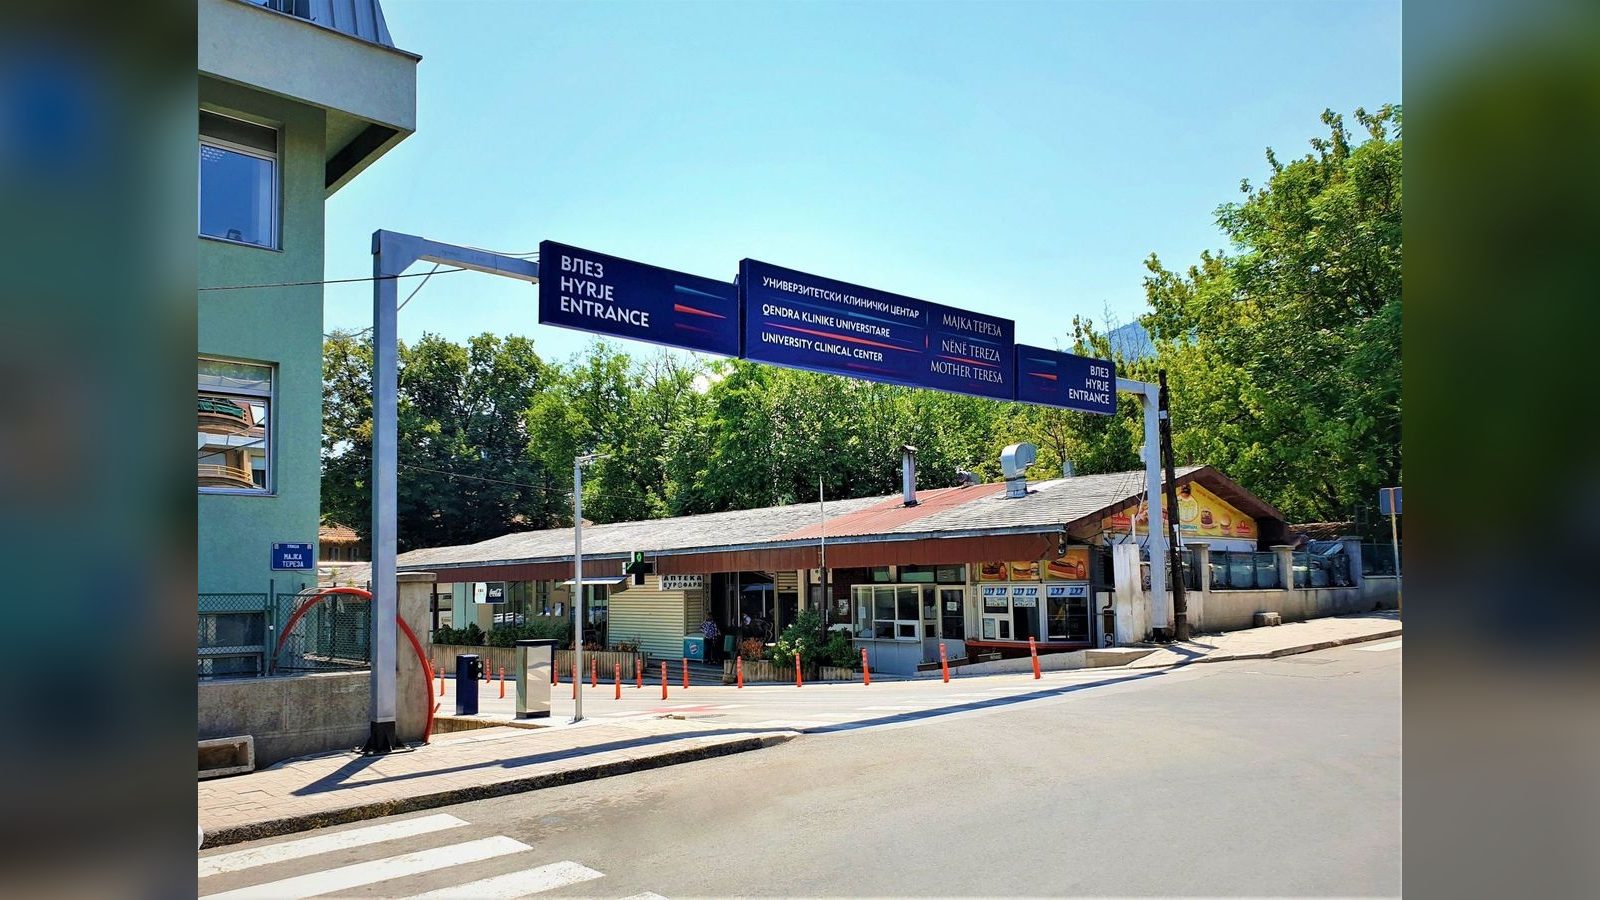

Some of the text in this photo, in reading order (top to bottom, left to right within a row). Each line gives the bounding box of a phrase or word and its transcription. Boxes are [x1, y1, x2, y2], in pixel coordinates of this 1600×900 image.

[561, 255, 604, 278] ВЛЕЗ
[560, 275, 614, 302] HYRJE
[762, 276, 920, 319] УНИВЕРЗИТЕТСКИ КЛИНИЧКИ ЦЕНТАР
[560, 295, 650, 328] ENTRANCE
[762, 303, 891, 338] QENDRA KLINIKE UNIVERSITARE
[942, 313, 1002, 337] МАЈКА ТЕРЕЗА
[761, 332, 883, 363] UNIVERSITY CLINICAL CENTER
[968, 344, 1001, 362] TEREZA
[930, 360, 1003, 384] MOTHER TERESA
[1089, 365, 1110, 379] ВЛЕЗ
[1068, 388, 1110, 405] ENTRANCE
[1085, 377, 1110, 392] HYRJE
